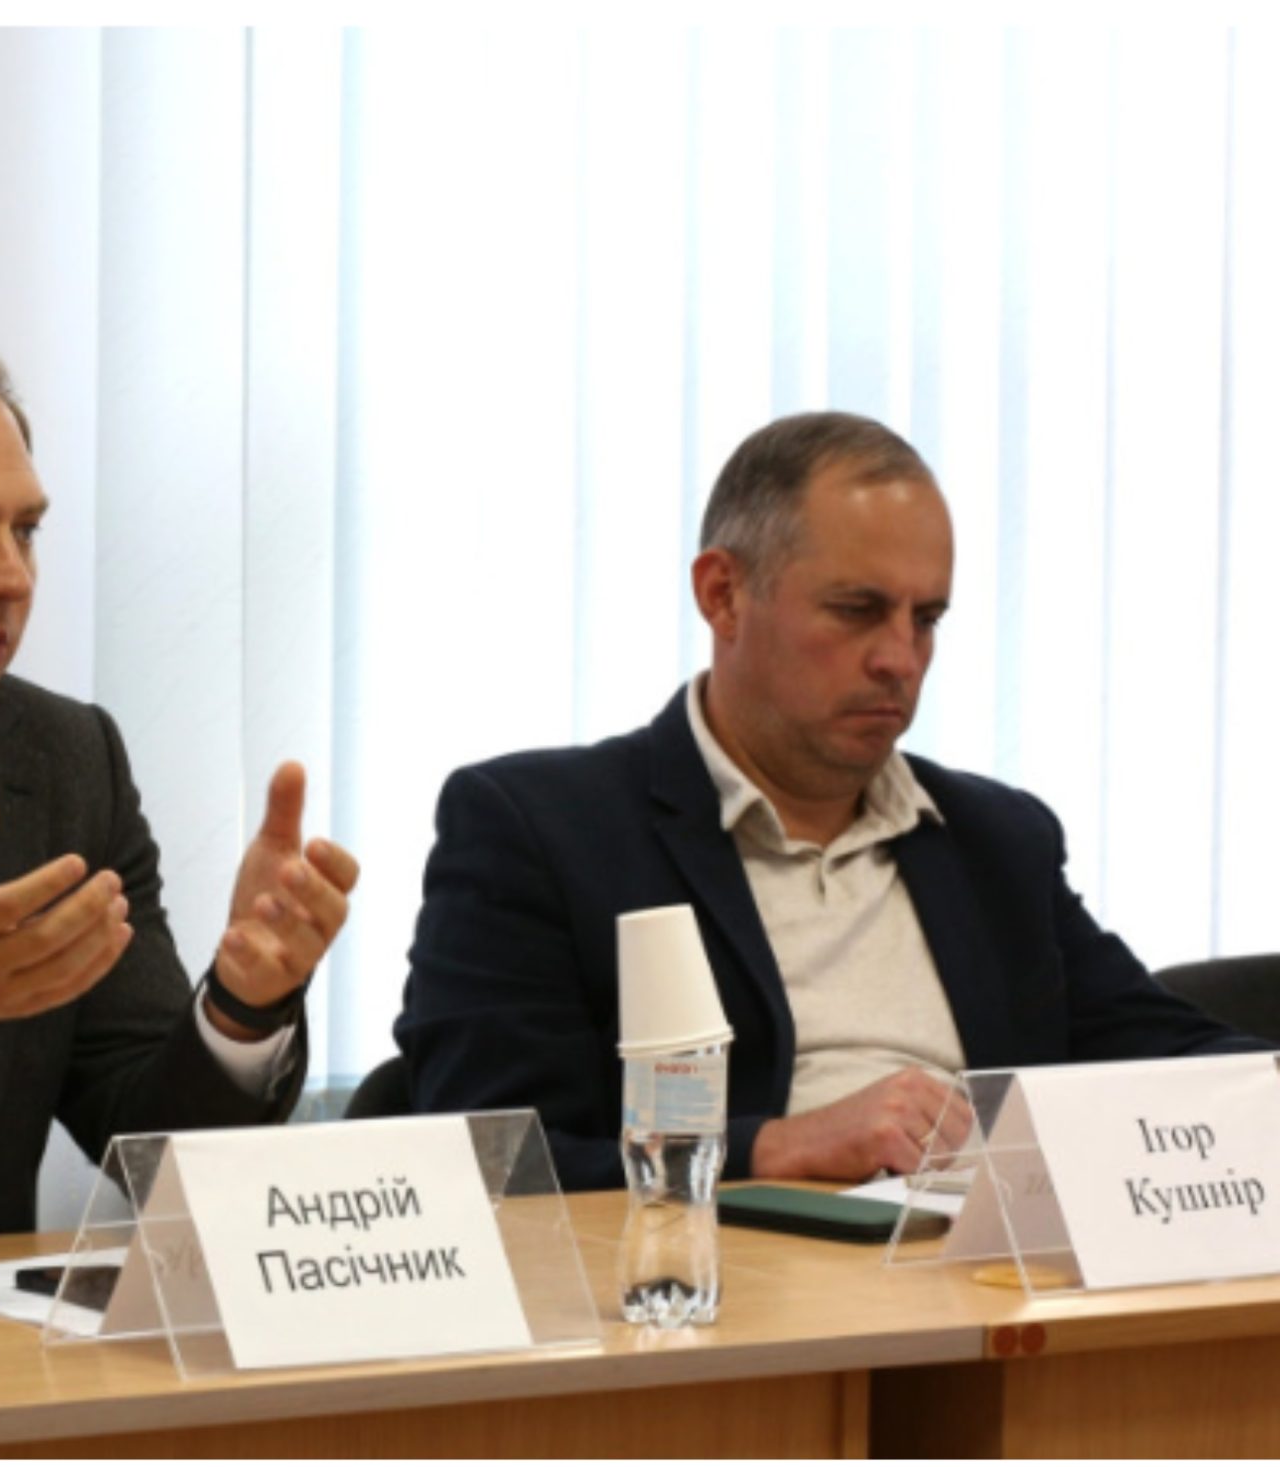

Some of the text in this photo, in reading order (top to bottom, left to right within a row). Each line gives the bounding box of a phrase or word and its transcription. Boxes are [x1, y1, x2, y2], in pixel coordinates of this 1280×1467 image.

[1137, 1117, 1216, 1160] Ігор
[266, 1177, 422, 1231] Андрій
[1124, 1168, 1265, 1224] Кушнір
[256, 1245, 466, 1293] Пасічник
